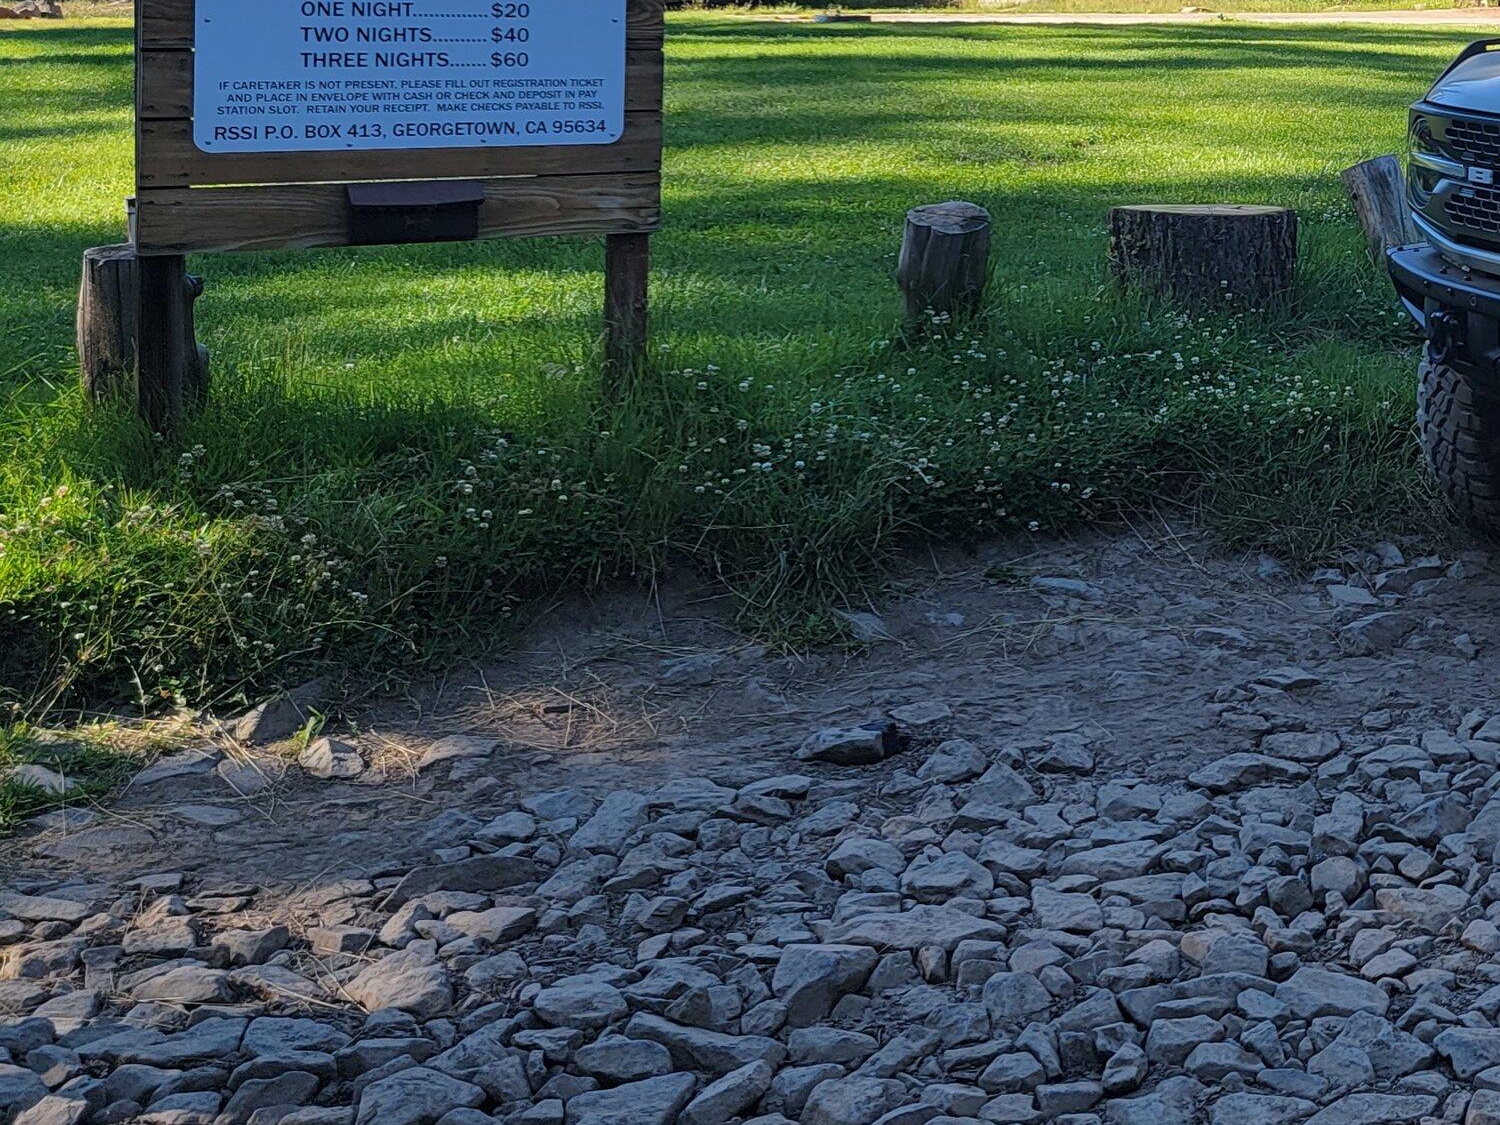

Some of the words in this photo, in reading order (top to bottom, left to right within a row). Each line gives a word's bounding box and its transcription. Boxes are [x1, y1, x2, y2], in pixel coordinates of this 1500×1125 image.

[301, 1, 345, 17] ONE
[491, 2, 530, 19] $20
[300, 26, 349, 43] TWO
[490, 27, 529, 44] $40
[300, 52, 368, 68] THREE
[490, 52, 529, 68] $60
[219, 81, 230, 90] IF
[232, 80, 302, 90] CARETAKER
[305, 80, 316, 90] IS
[319, 80, 342, 90] NOT
[401, 79, 442, 89] PLEASE
[445, 79, 467, 88] FILL
[469, 79, 491, 88] OUT
[493, 78, 567, 88] REGISTRATION
[570, 78, 604, 87] TICKET
[227, 93, 253, 103] AND
[256, 93, 293, 102] PLACE
[296, 93, 308, 102] IN
[311, 92, 369, 102] ENVELOPE
[371, 92, 400, 101] WITH
[403, 91, 433, 101] CASH
[435, 91, 452, 100] OR
[454, 91, 490, 100] CHECK
[492, 90, 516, 99] AND
[518, 90, 562, 99] DEPOSIT
[565, 90, 575, 98] IN
[578, 90, 597, 98] PAY
[217, 105, 265, 115] STATION
[306, 105, 347, 114] RETAIN
[349, 104, 380, 113] YOUR
[437, 103, 467, 112] MAKE
[470, 102, 513, 111] CHECKS
[515, 101, 560, 110] PAYABLE
[562, 101, 576, 110] TO
[214, 126, 258, 141] RSSI
[265, 125, 298, 140] P.O.
[305, 124, 341, 139] BOX
[346, 123, 387, 139] 413,
[392, 121, 520, 137] GEORGETOWN,
[525, 120, 548, 134] CA
[552, 119, 606, 134] 95634
